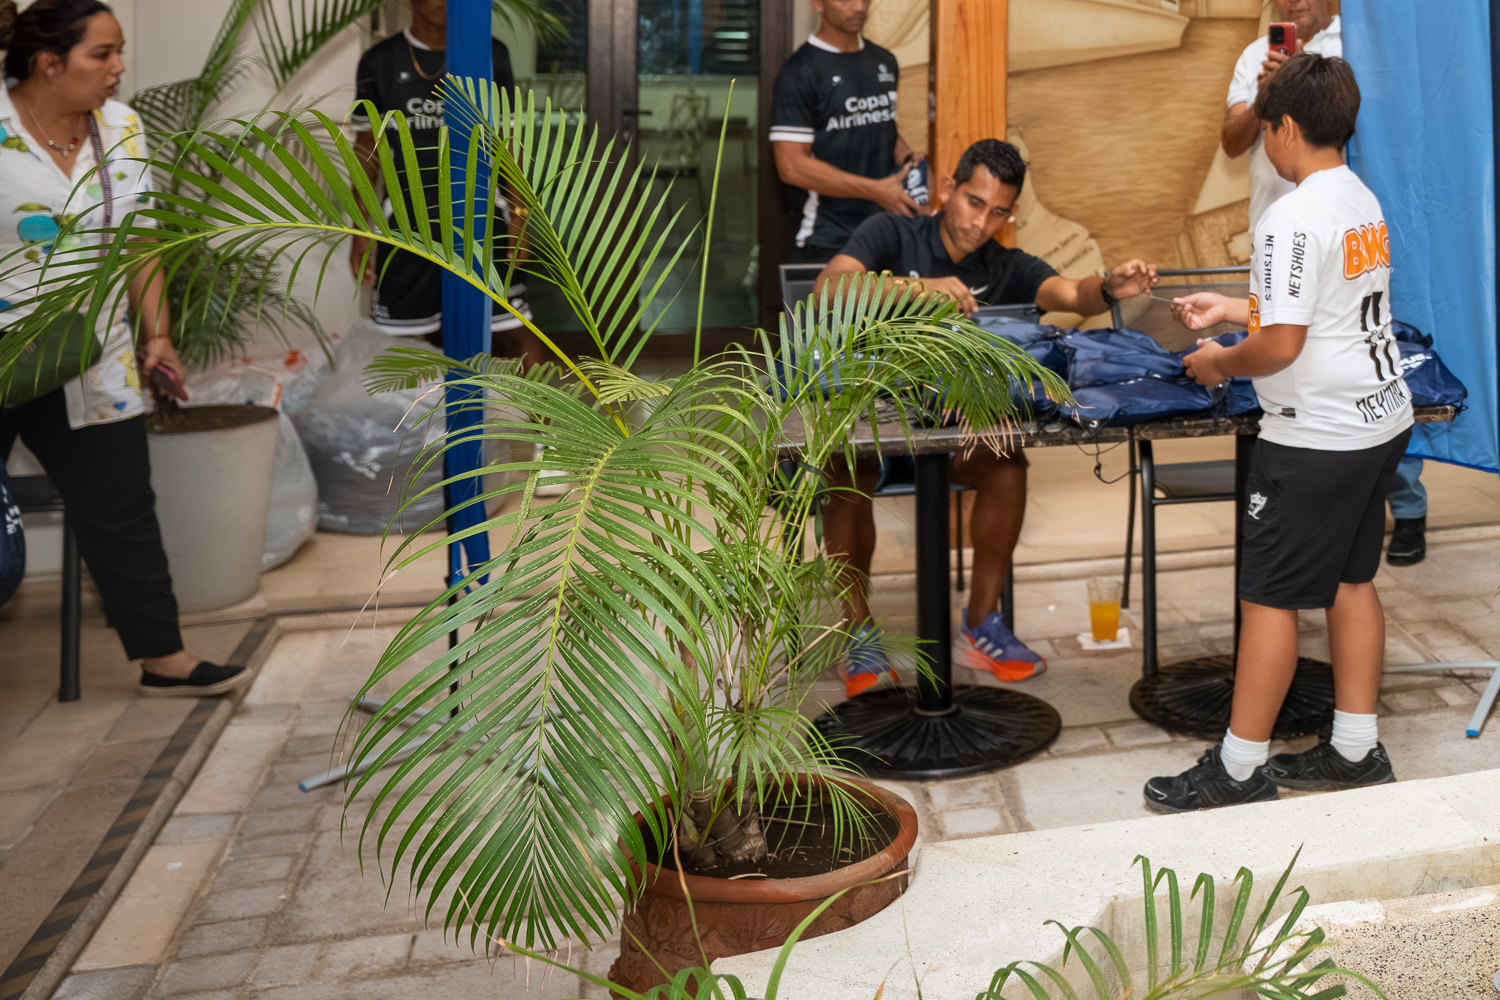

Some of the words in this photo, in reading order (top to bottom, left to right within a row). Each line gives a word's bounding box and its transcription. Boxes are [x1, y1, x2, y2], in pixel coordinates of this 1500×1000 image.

[406, 97, 445, 116] Cop
[845, 92, 889, 112] Copa
[825, 107, 891, 132] Airlines
[1288, 231, 1307, 298] NETSHOES
[1342, 220, 1391, 280] BMG
[1356, 379, 1407, 423] NEYMAR
